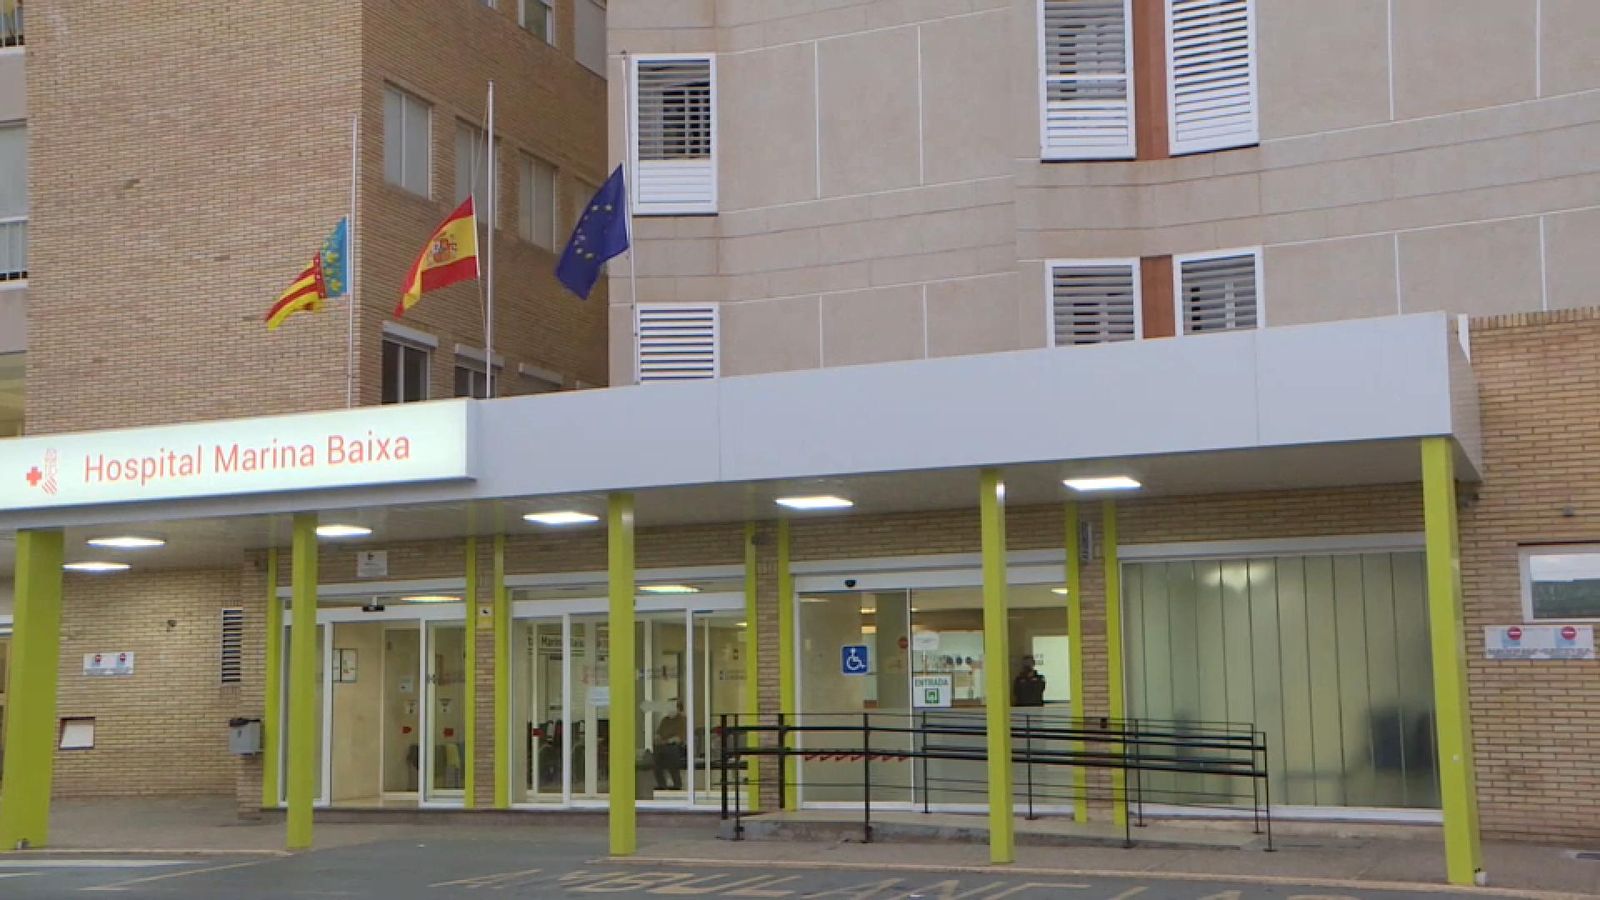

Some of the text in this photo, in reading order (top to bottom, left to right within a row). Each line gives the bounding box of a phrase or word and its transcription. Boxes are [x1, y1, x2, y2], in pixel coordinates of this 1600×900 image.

[84, 429, 410, 486] Hospital Marina Baixa
